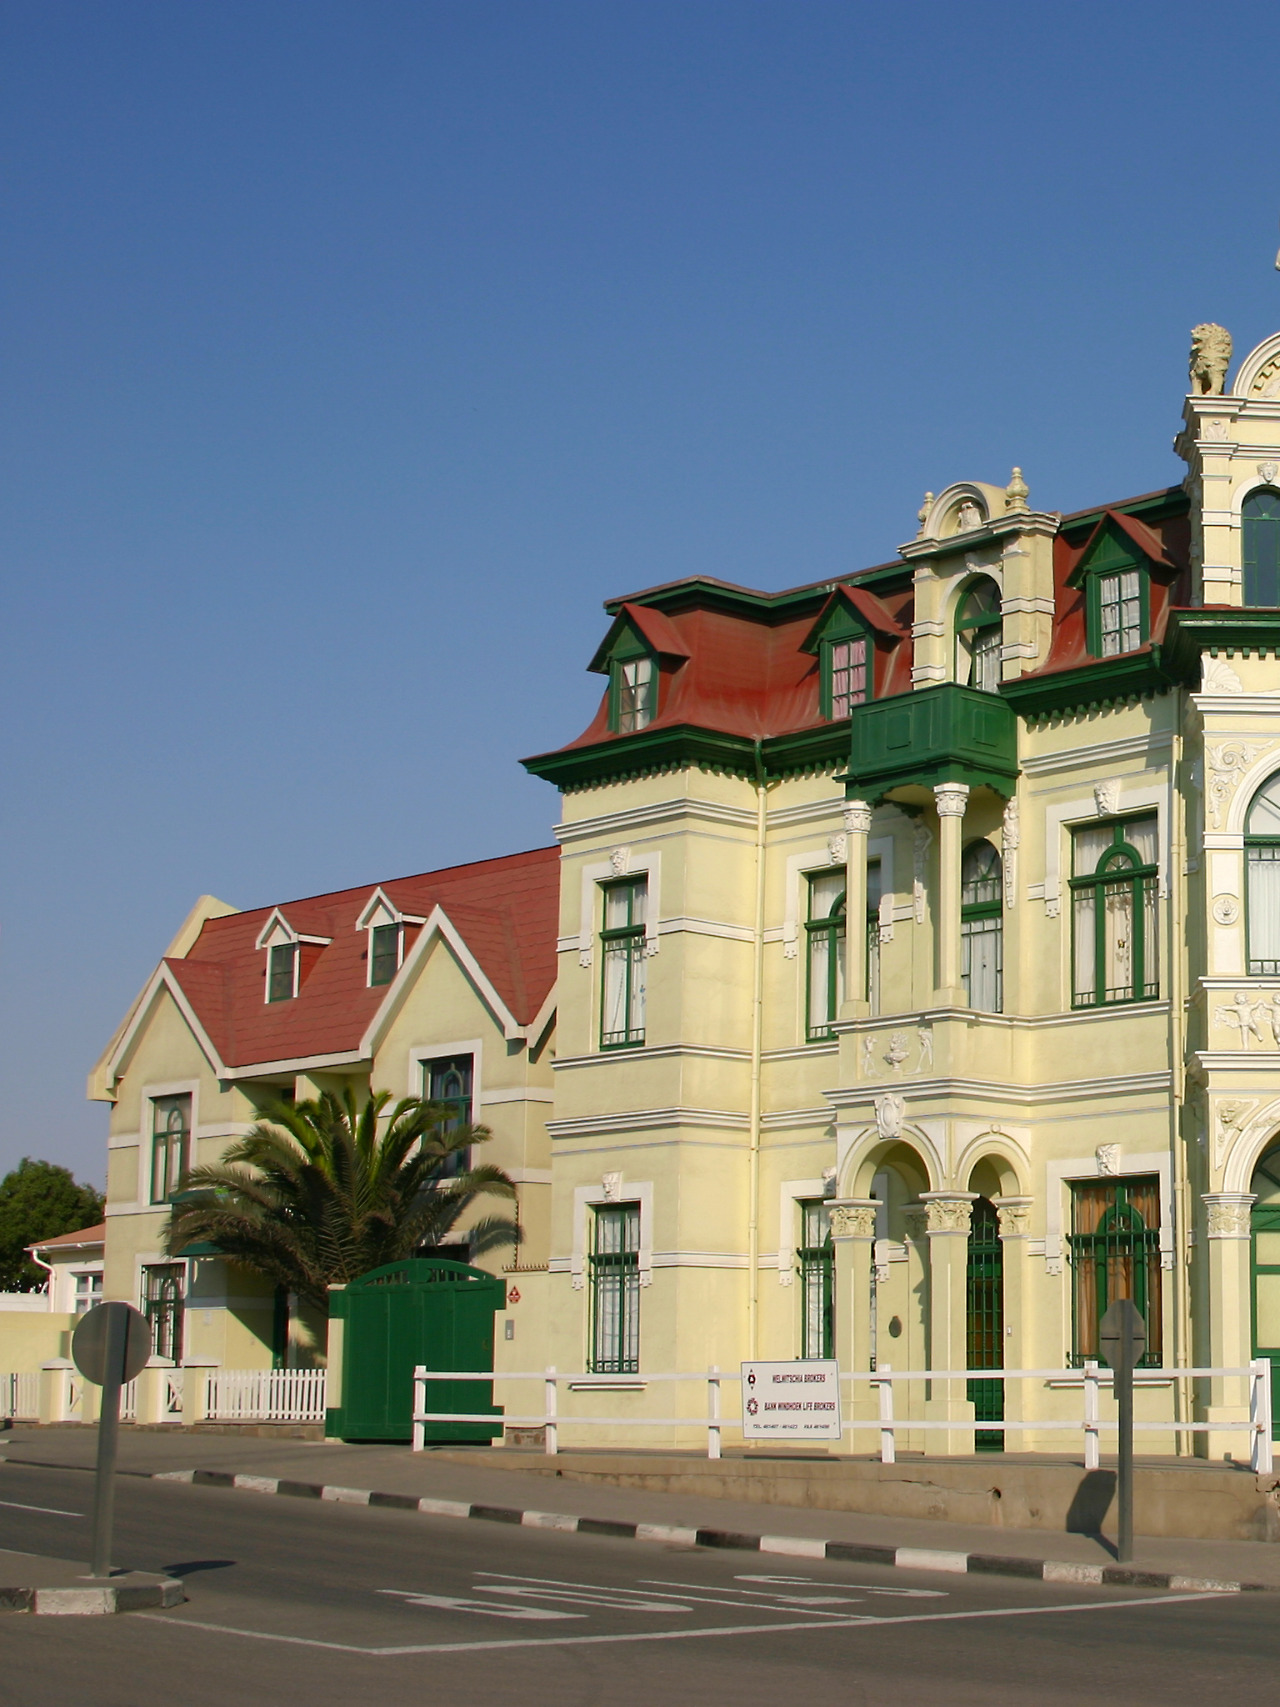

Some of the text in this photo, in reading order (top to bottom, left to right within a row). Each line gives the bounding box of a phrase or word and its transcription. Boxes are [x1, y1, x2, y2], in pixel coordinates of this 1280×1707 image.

[804, 1374, 825, 1382] BROKERS
[764, 1402, 835, 1410] BANK WINDHOEK LIFE BROKERS
[375, 1572, 951, 1620] STOP
